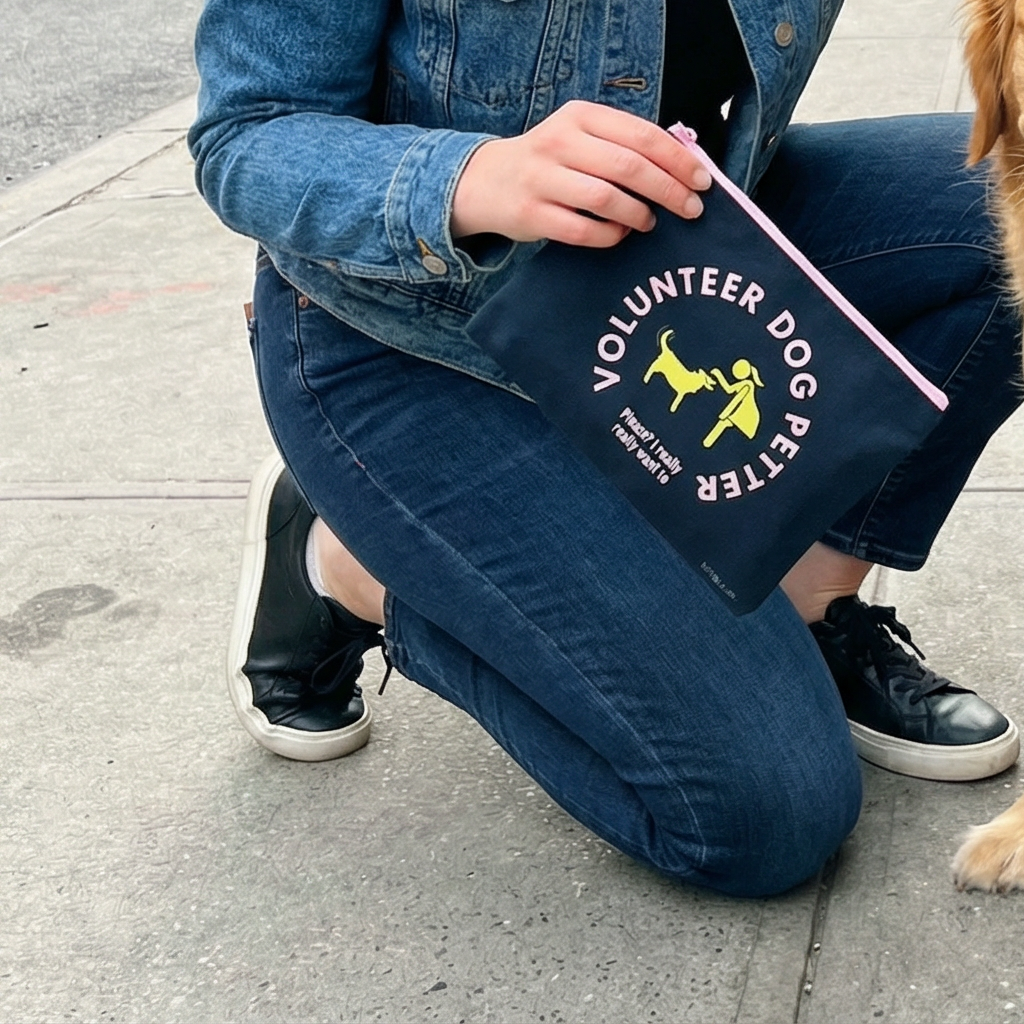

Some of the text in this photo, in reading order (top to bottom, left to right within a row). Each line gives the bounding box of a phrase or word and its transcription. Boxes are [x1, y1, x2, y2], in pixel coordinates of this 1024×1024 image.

[593, 267, 817, 502] VOLUNTEER DOG PETTER
[611, 423, 670, 485] really want to
[649, 439, 660, 450] I
[654, 445, 683, 475] really
